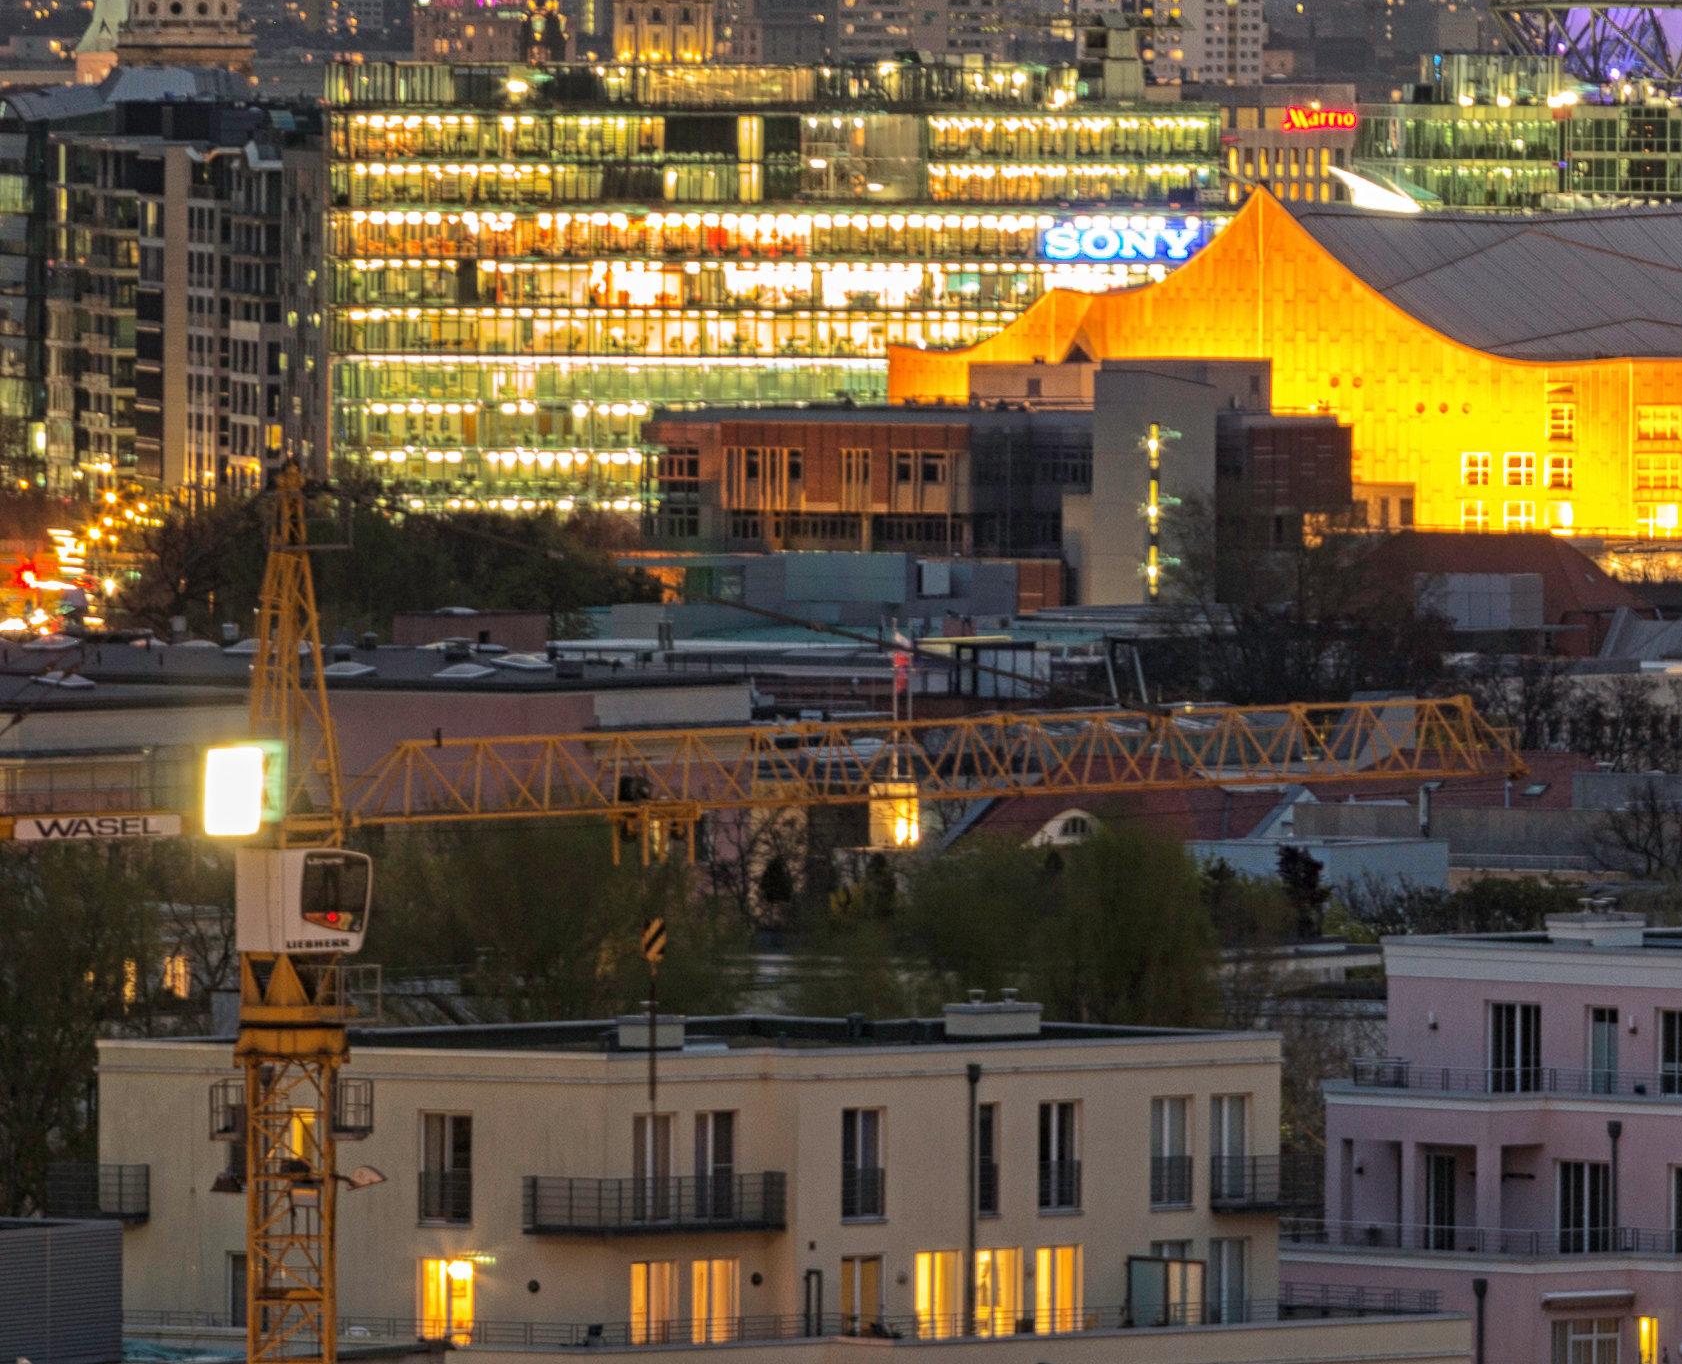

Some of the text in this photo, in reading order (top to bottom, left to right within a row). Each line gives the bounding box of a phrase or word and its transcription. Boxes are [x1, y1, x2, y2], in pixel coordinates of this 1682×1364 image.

[1044, 226, 1200, 261] SONY
[35, 817, 162, 837] WASEL
[286, 938, 350, 949] LIEBHERR
